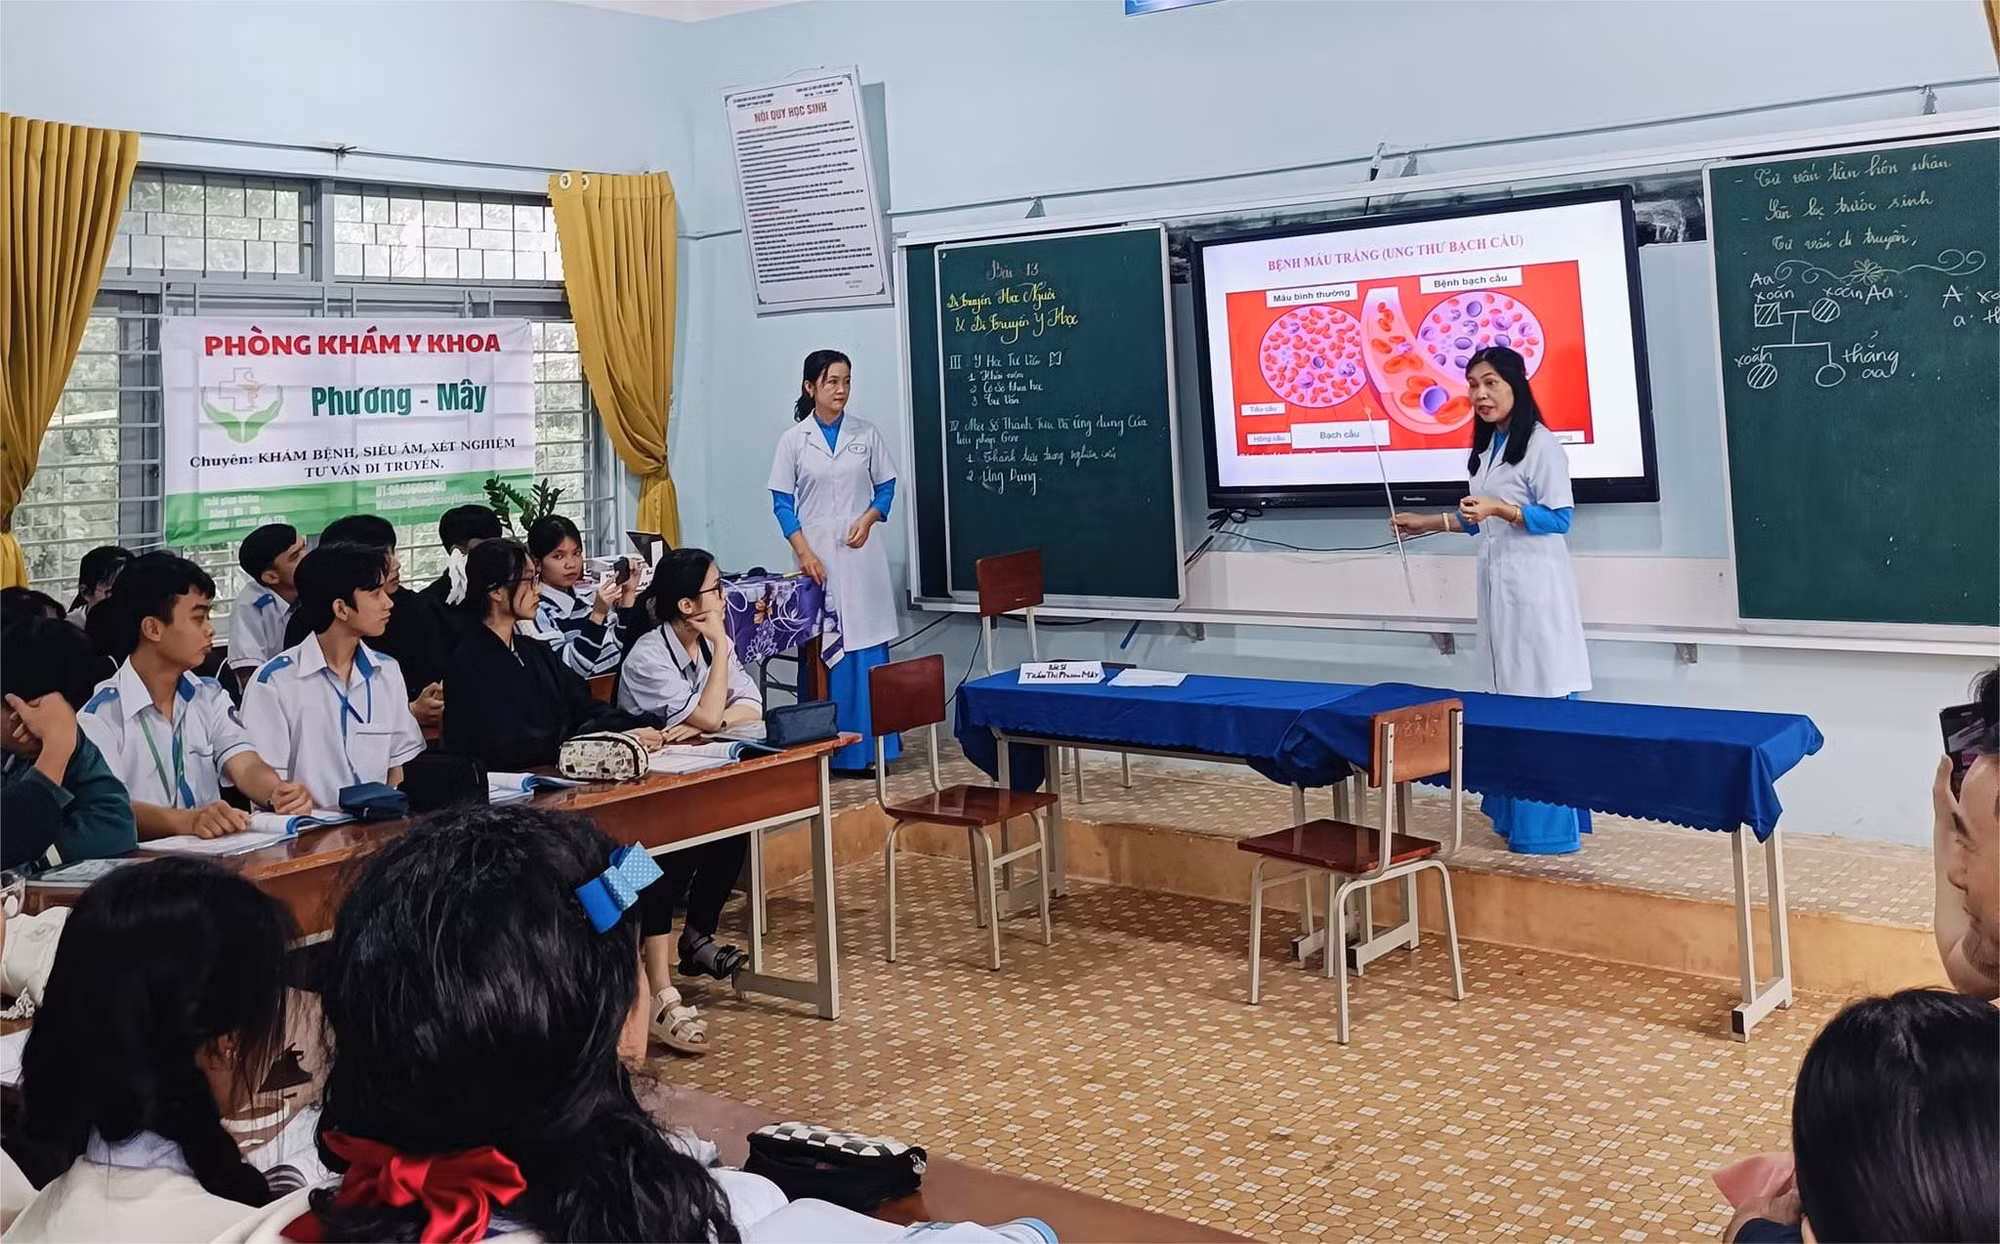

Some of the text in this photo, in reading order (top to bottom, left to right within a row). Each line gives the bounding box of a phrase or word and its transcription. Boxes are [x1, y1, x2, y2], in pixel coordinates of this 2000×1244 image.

[770, 107, 786, 120] QUY
[788, 105, 805, 119] HỌC
[806, 102, 828, 115] SINH
[1886, 190, 1935, 209] sinh
[1838, 229, 1852, 248] di
[1268, 258, 1301, 273] BỆNH
[1304, 253, 1332, 268] MÁU
[1382, 246, 1415, 262] (UNG
[1416, 241, 1446, 257] THƯ
[1449, 238, 1487, 254] BẠCH
[1026, 262, 1039, 276] 13
[1433, 277, 1460, 289] Bệnh
[1462, 275, 1487, 287] bạch
[1750, 272, 1775, 288] Aa
[1273, 292, 1293, 303] Máu
[1294, 289, 1315, 301] bình
[1865, 284, 1894, 305] Aa
[205, 325, 501, 356] PHÒNG KHÁM Y KHOA
[1862, 368, 1891, 379] aa
[312, 385, 412, 416] Phương
[437, 379, 487, 413] Mây
[1319, 429, 1360, 440] Bạch cầu
[190, 453, 253, 469] Chuyên:
[258, 448, 307, 464] KHÁM
[313, 447, 359, 462] BỆNH,
[363, 443, 397, 458] SIÊU
[431, 440, 456, 453] XÉT
[461, 436, 515, 451] NGHIỆM
[304, 466, 329, 478] TƯ
[331, 462, 360, 476] VẤN
[366, 463, 380, 474] DI
